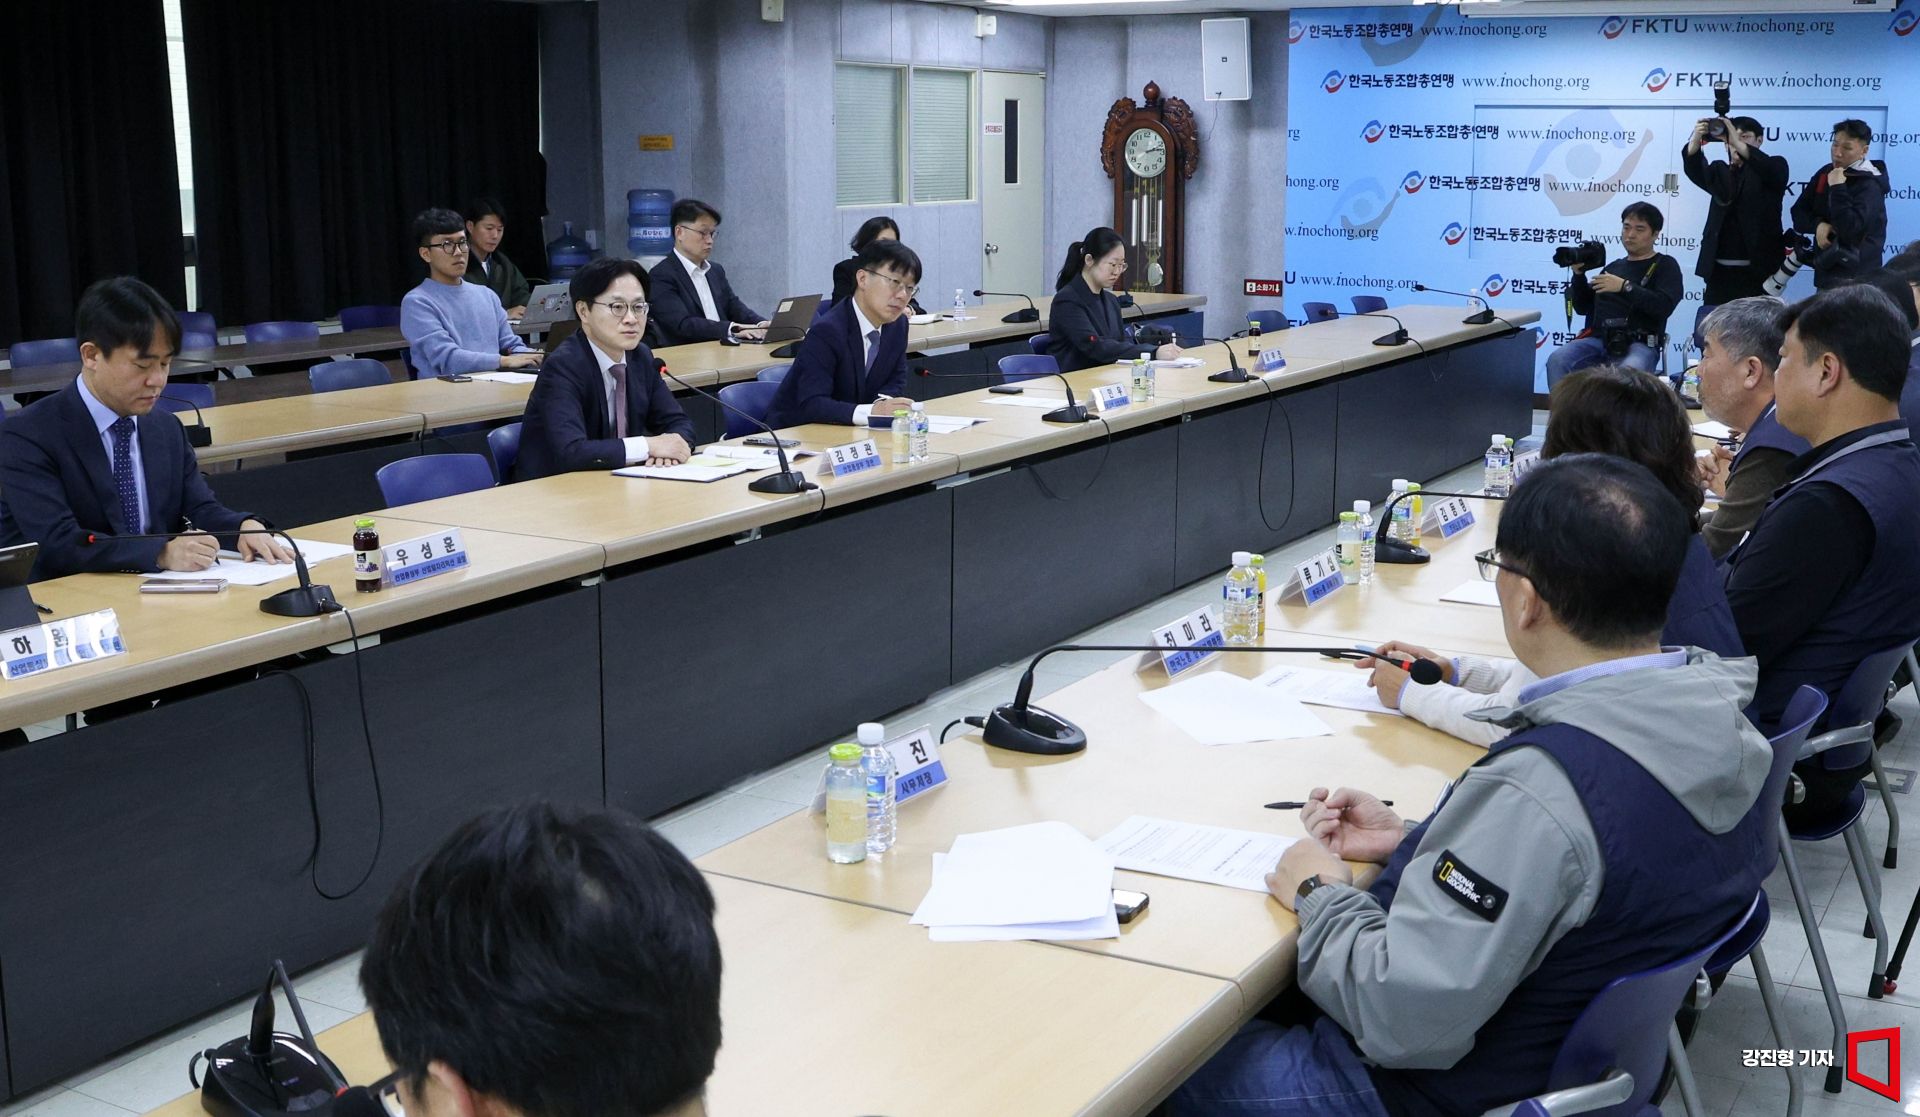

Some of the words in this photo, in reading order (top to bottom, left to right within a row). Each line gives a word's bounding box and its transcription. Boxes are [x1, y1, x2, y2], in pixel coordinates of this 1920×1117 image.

[1309, 23, 1413, 38] 한국노동조합총연맹
[1420, 20, 1547, 38] www.inochong.org
[1632, 18, 1688, 33] FKTU
[1694, 16, 1834, 34] www.inochong.org
[1349, 74, 1454, 89] 한국노동조합총연맹
[1462, 72, 1590, 91] www.inochong.org
[1739, 71, 1882, 91] www.inochong.org
[1389, 124, 1499, 140] 한국노동조합총연맹
[1507, 124, 1636, 143] www.inochong.org
[1429, 174, 1540, 192] 한국노동조합총연맹
[1549, 177, 1680, 197] www.inochong.og
[1473, 226, 1582, 244] 한국노동조합총연맹
[1256, 283, 1275, 292] 소화기
[396, 536, 456, 566] 우성훈
[1446, 875, 1481, 903] GEOGRAPHIC
[1450, 868, 1475, 891] NATIONAL
